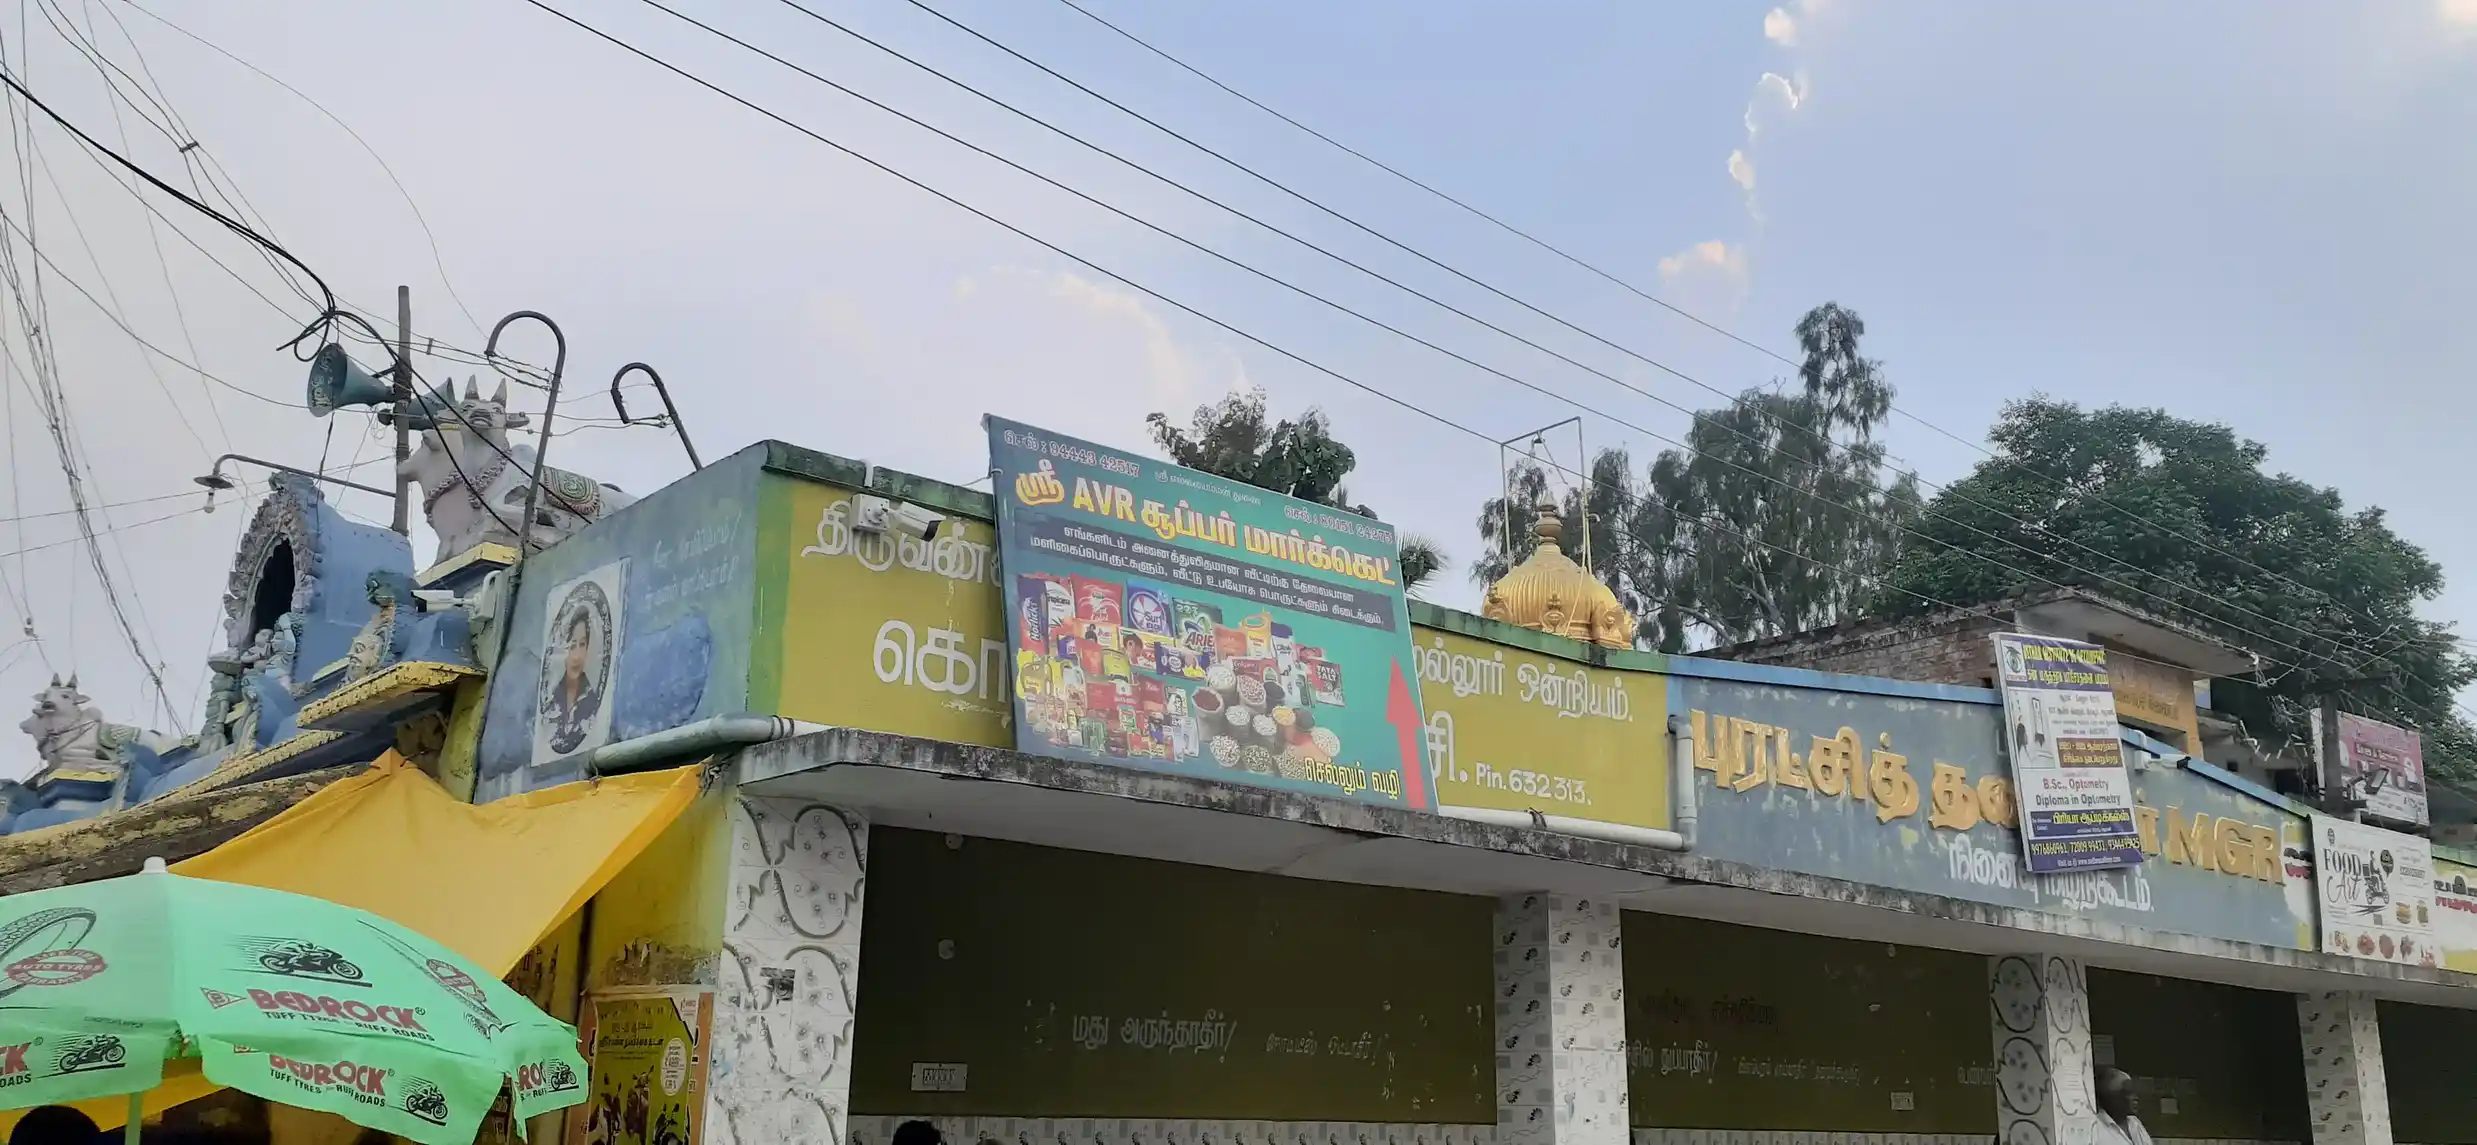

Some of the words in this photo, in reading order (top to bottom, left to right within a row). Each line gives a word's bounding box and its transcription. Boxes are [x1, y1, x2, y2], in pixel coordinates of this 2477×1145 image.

[1049, 440, 1097, 467] 94443
[1100, 454, 1141, 478] 42517
[1063, 526, 1128, 550] எங்களிடம்
[1072, 476, 1137, 523] AVR
[1141, 498, 1237, 549] சூப்பர்
[1243, 525, 1396, 586] மார்க்கெட்
[1315, 665, 1337, 676] TATA
[1316, 671, 1338, 683] SALT
[873, 619, 1009, 703] கொ
[1426, 709, 1469, 783] சி.
[1516, 662, 1634, 723] ஒன்றியம்.
[1304, 757, 1367, 796] செல்லும்
[1371, 769, 1401, 800] வழி
[1688, 708, 1920, 825] புரட்சித்
[2166, 805, 2287, 886] MGR
[2068, 778, 2109, 792] Optometry
[2035, 794, 2070, 808] Diploma
[2071, 794, 2080, 805] in
[2081, 794, 2121, 808] Optometry
[2323, 847, 2362, 878] FOOD
[246, 988, 428, 1033] BEDROCK
[264, 1011, 296, 1021] TUFF
[391, 1027, 436, 1042] ROADS
[1072, 1013, 1110, 1051] மது
[0, 1041, 33, 1076] K
[270, 1067, 292, 1084] TUFF
[294, 1078, 322, 1094] TYRES
[354, 1092, 386, 1108] ROADS
